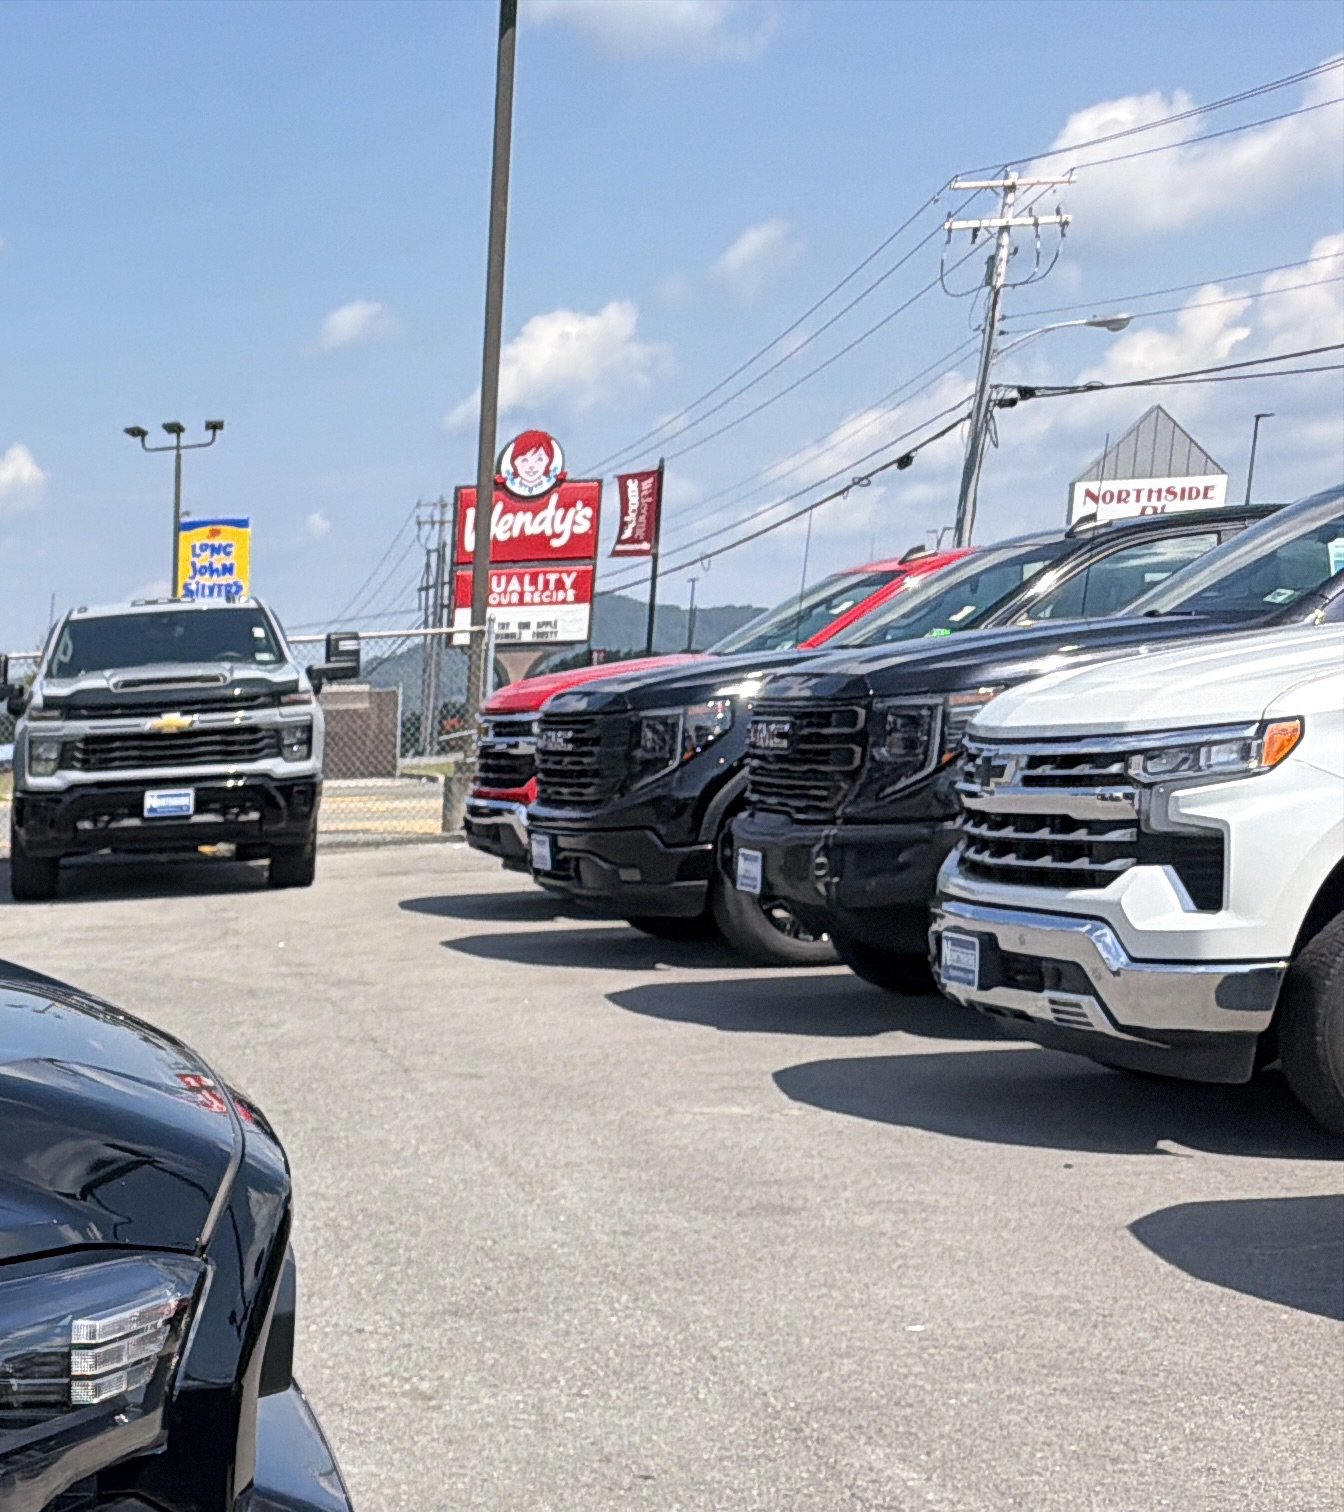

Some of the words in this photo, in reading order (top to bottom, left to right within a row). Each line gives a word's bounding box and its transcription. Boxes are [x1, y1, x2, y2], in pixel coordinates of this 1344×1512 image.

[1083, 485, 1216, 507] NORTHSIDE
[191, 543, 233, 558] LONG
[490, 572, 578, 593] UALITY
[488, 591, 520, 605] OUR
[523, 589, 576, 604] RECIPE
